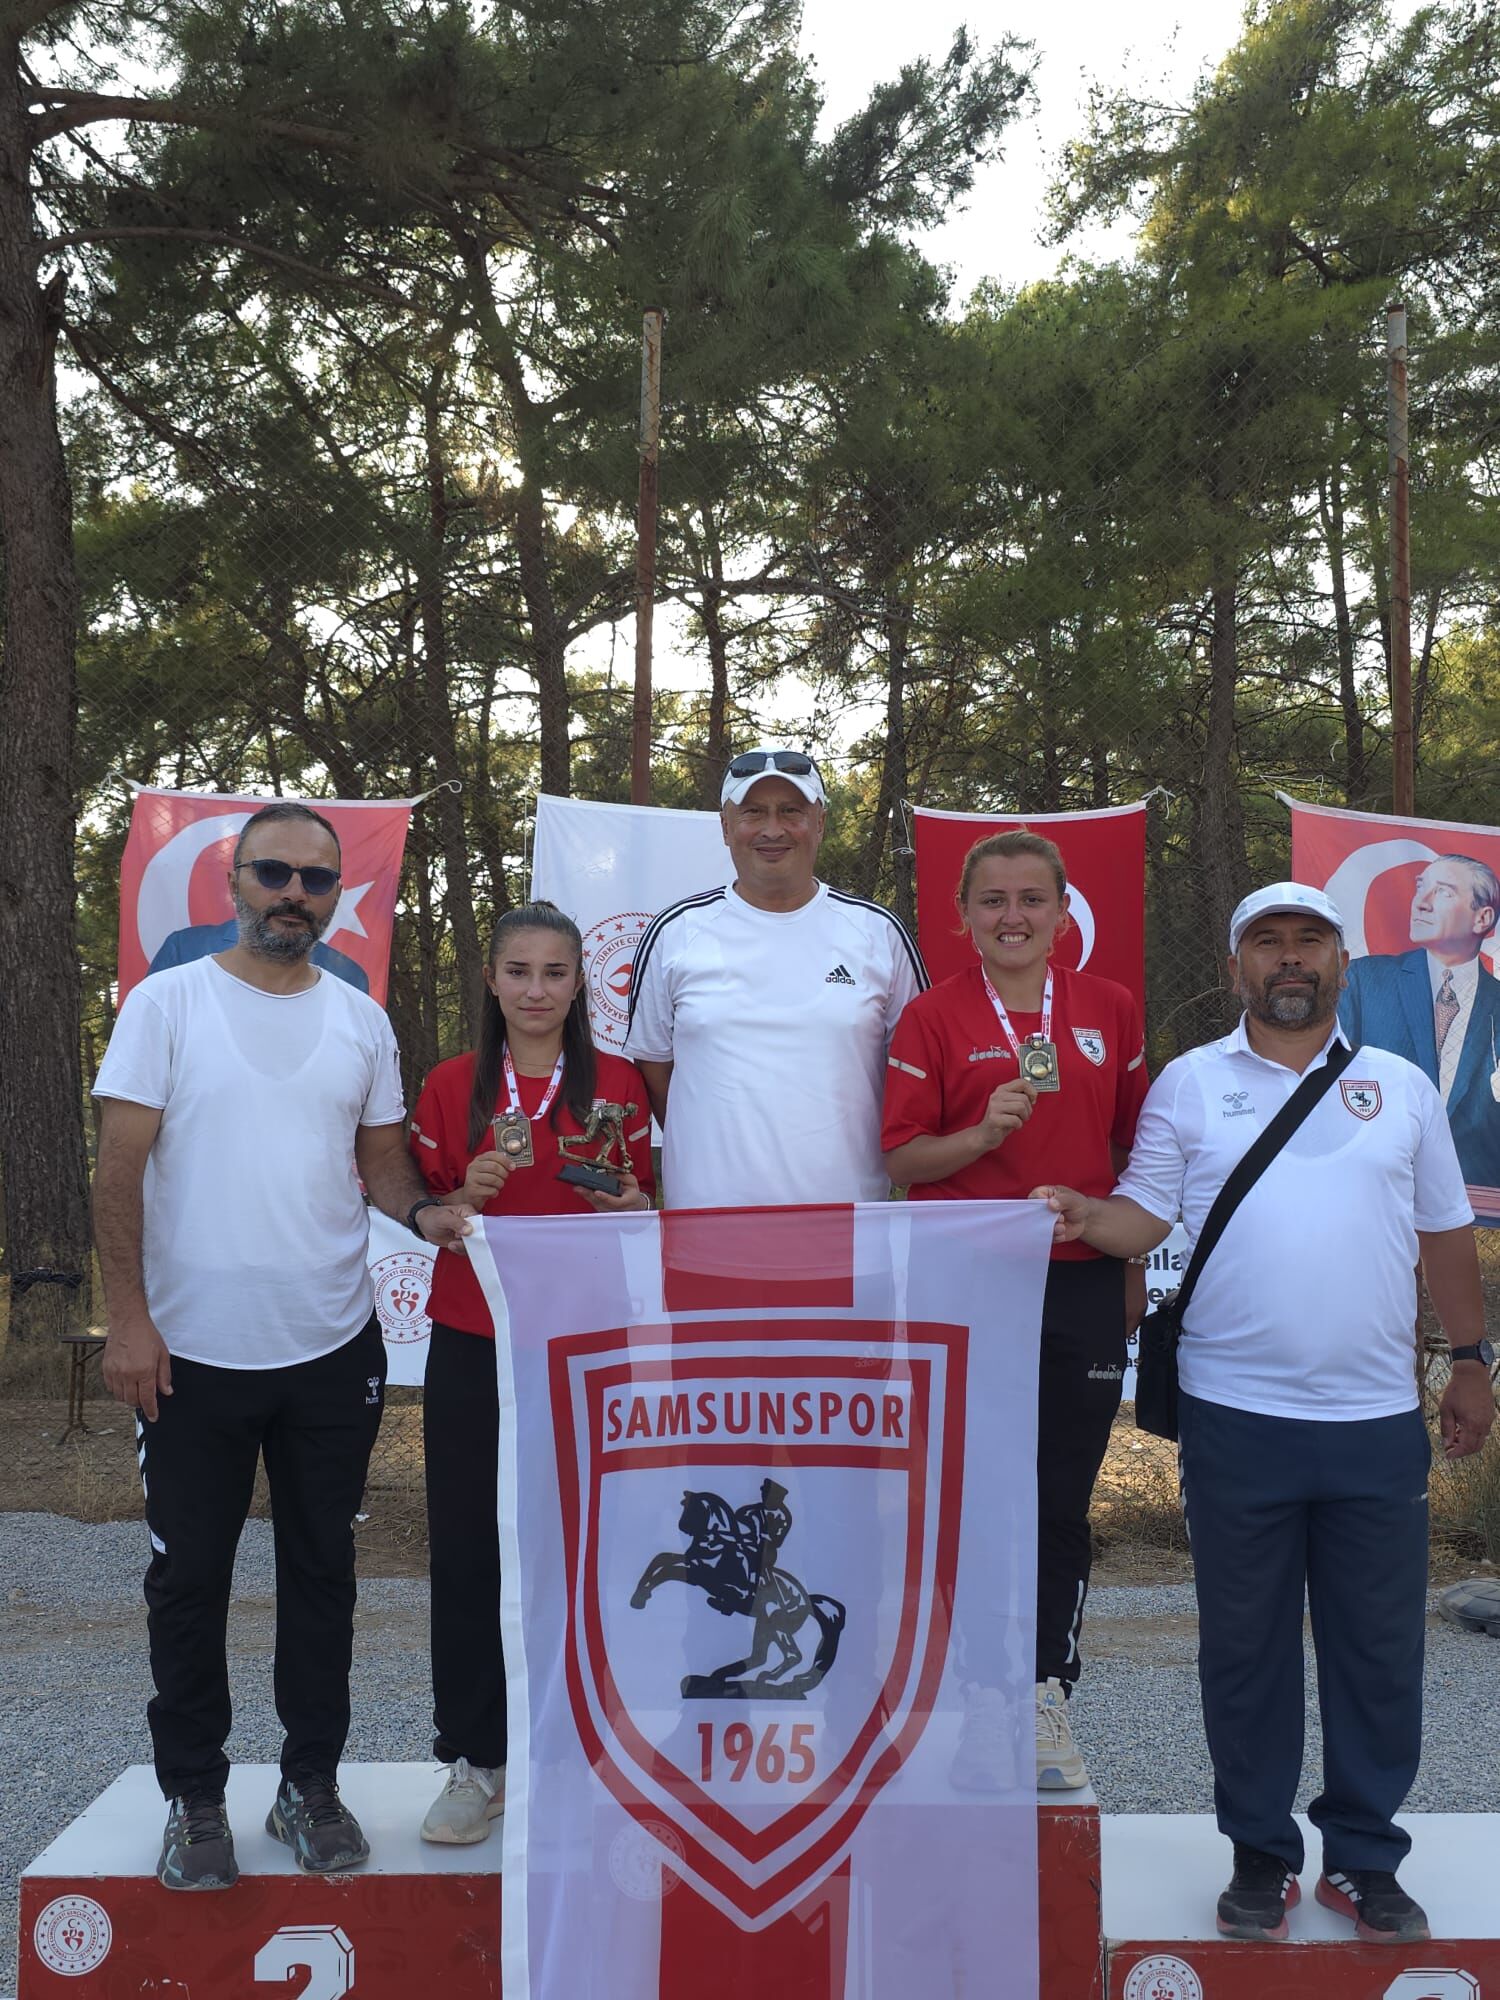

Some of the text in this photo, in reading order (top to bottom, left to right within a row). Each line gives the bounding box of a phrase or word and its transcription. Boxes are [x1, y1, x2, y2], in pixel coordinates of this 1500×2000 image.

[595, 936, 639, 966] TÜRKİYE CU
[825, 976, 856, 986] adidas
[1222, 1106, 1256, 1118] hummel
[607, 1391, 904, 1442] SAMSUNSPOR
[697, 1721, 816, 1784] 1965
